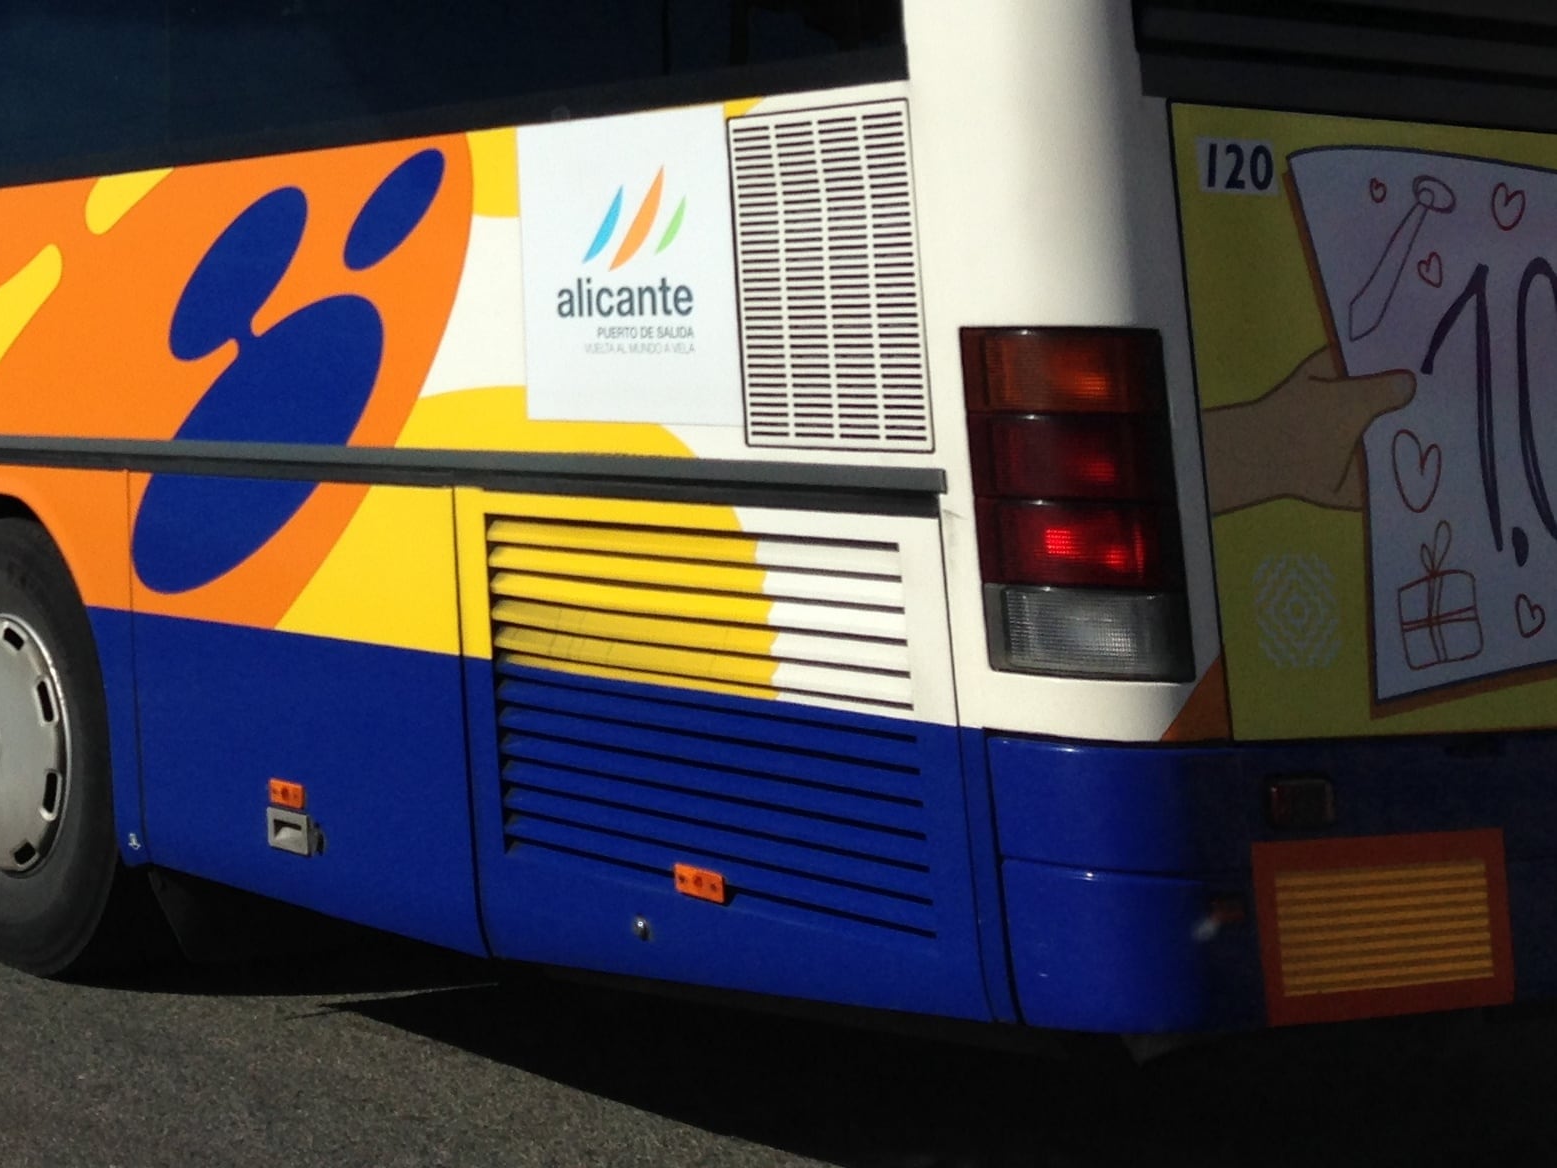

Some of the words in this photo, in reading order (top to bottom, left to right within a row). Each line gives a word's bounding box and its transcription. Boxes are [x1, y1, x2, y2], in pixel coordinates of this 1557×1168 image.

[1207, 143, 1274, 190] 120
[557, 277, 694, 317] alicante
[597, 326, 637, 338] PUERTO
[640, 326, 654, 338] DE
[656, 325, 694, 338] SALIDA
